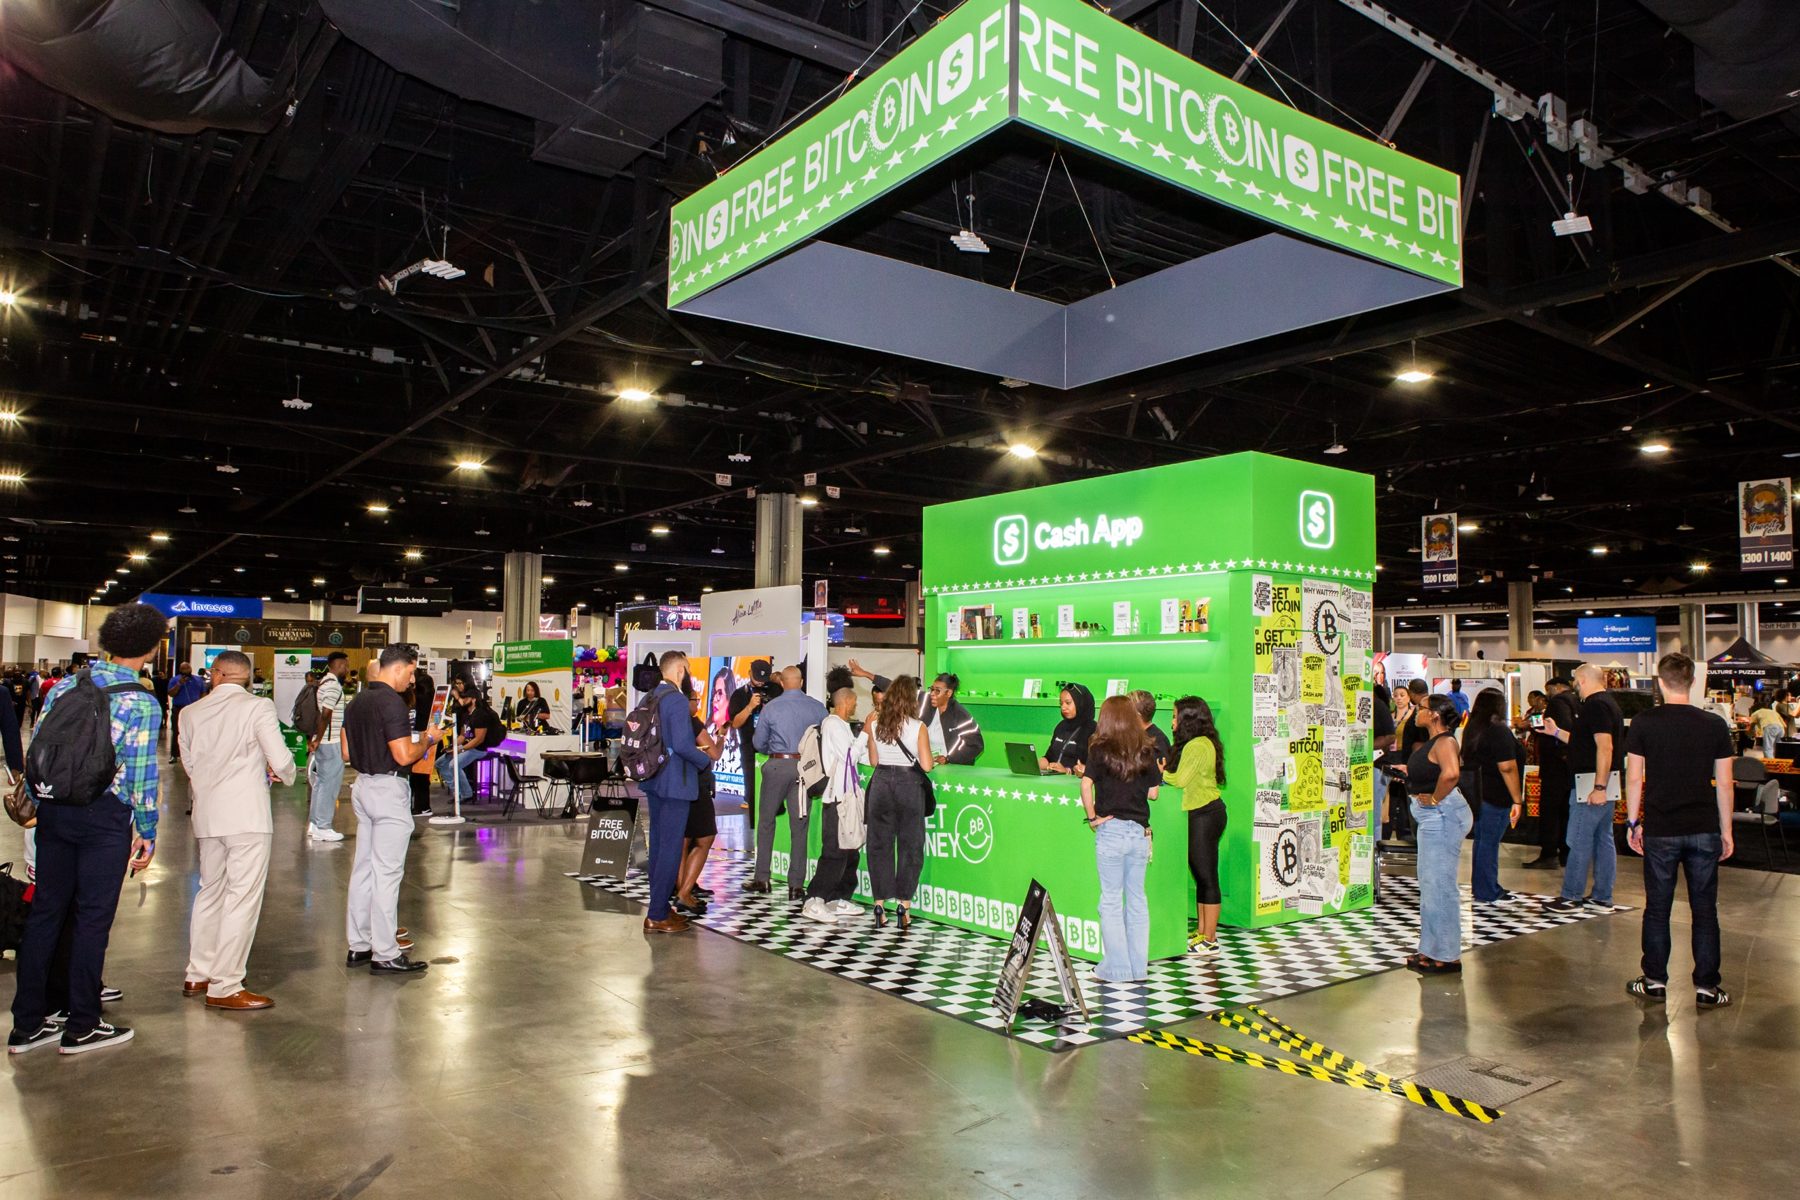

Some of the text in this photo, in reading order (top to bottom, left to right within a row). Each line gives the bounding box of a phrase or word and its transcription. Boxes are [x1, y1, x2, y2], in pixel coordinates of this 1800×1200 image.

[730, 157, 796, 237] FREE
[803, 60, 932, 195] BITCOIN
[1116, 53, 1281, 178] BITCOIN
[1323, 149, 1408, 227] FREE
[1034, 514, 1143, 550] Cash App
[1741, 551, 1792, 563] 1300 1400
[1442, 573, 1457, 582] 1300
[191, 601, 234, 613] Invesco
[1264, 629, 1284, 642] GET
[1305, 656, 1322, 664] BITCOIN
[1353, 765, 1369, 775] BITCOIN
[924, 804, 947, 829] ET
[599, 818, 623, 829] FREE
[590, 829, 629, 840] BITCOIN
[924, 832, 960, 858] NEY
